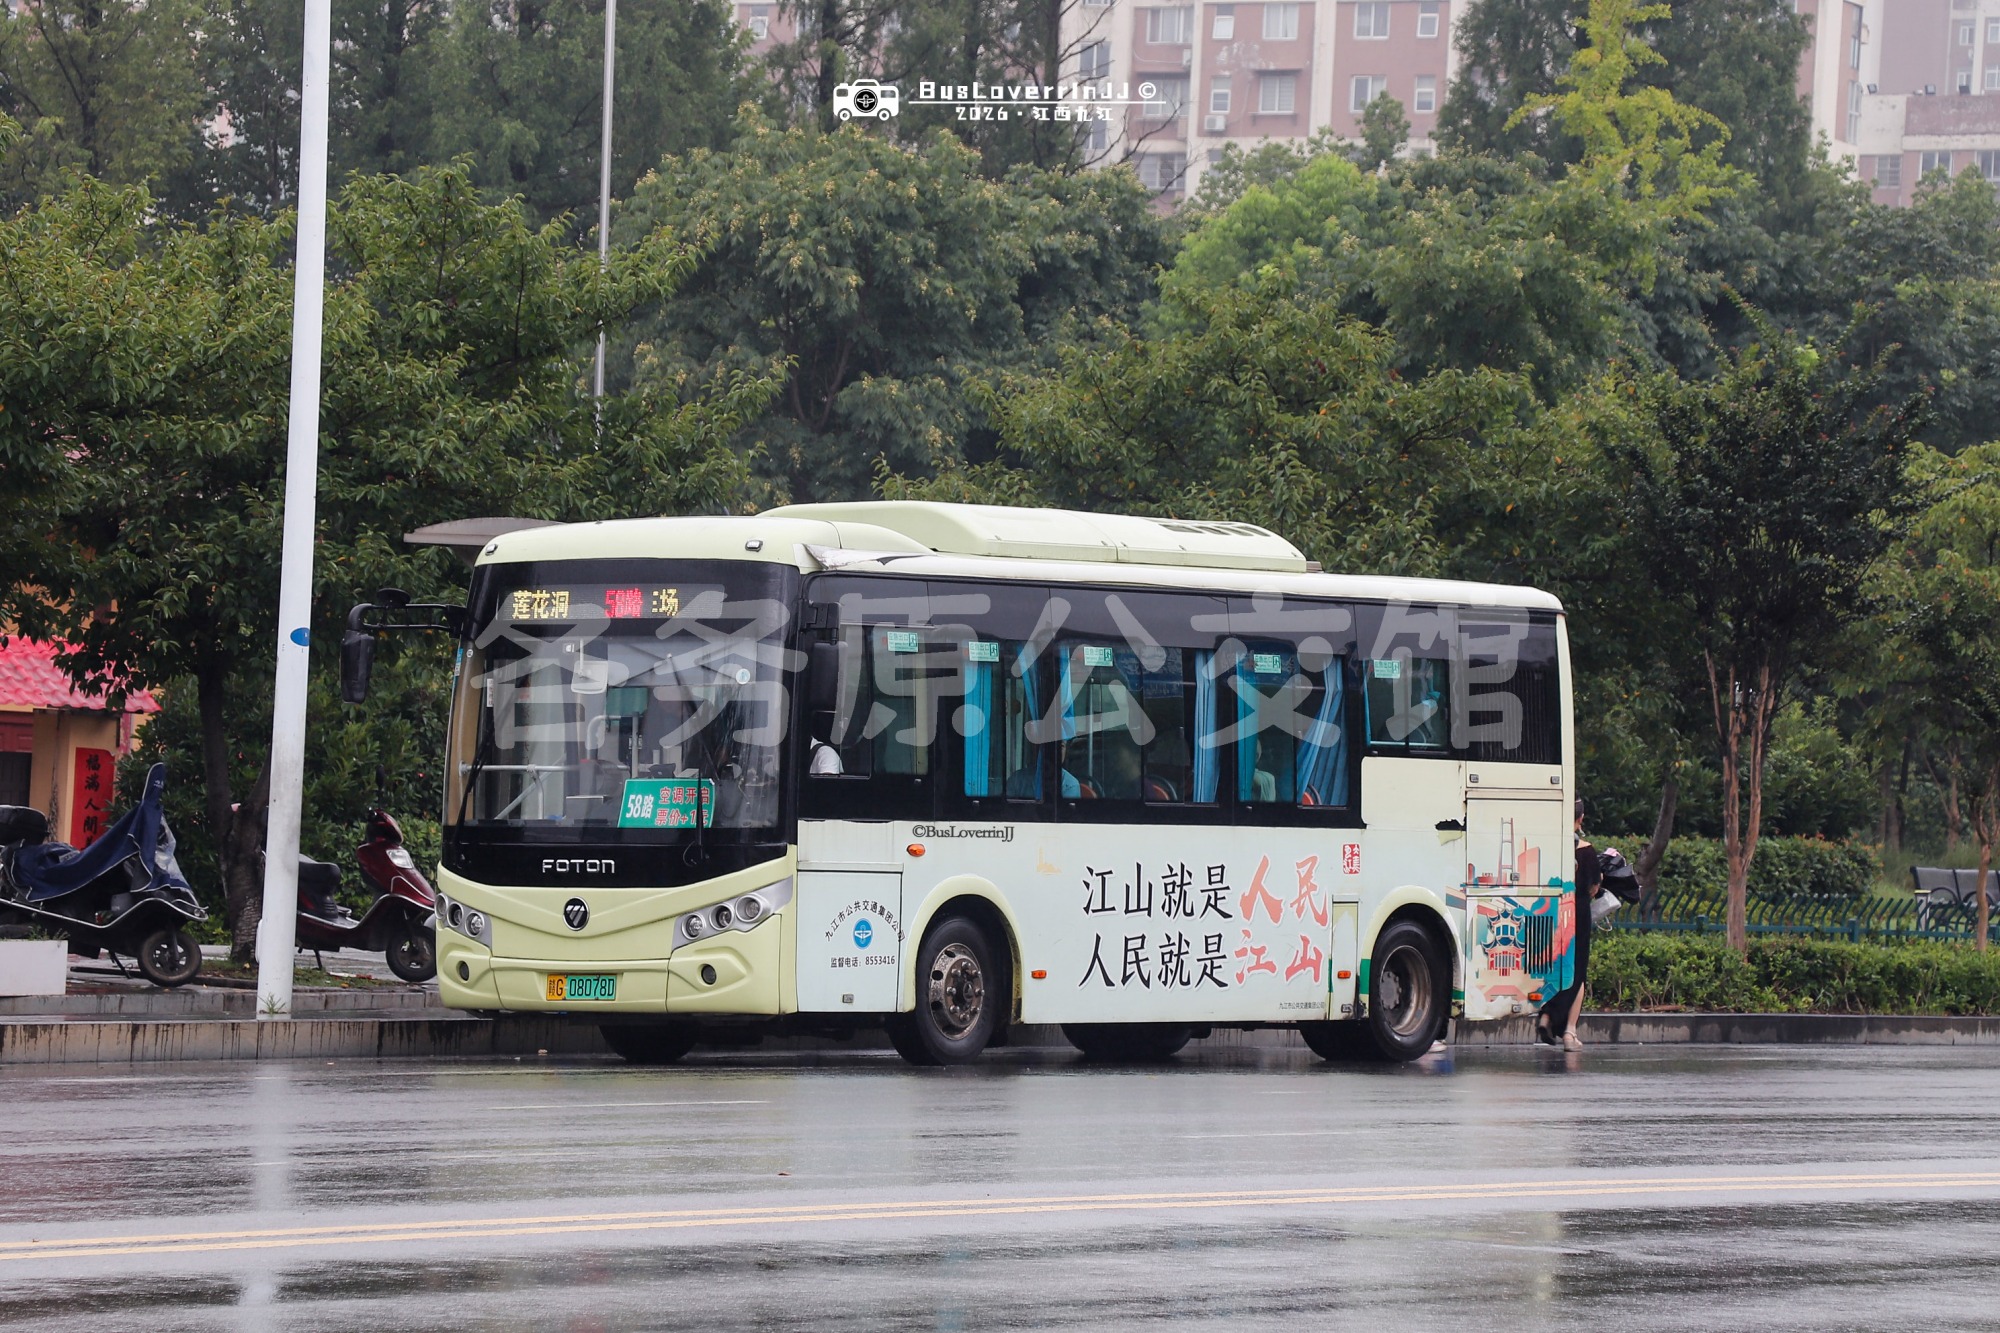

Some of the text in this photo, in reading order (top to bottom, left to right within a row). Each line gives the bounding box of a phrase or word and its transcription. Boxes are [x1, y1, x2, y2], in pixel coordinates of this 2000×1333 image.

[512, 590, 569, 619] 莲花洞
[605, 588, 643, 618] 58路
[626, 794, 654, 818] 58路
[659, 786, 710, 805] 空调开启
[542, 859, 615, 873] FOTON
[1082, 855, 1328, 926] 江山就是人民
[1078, 929, 1323, 990] 人民就是江山
